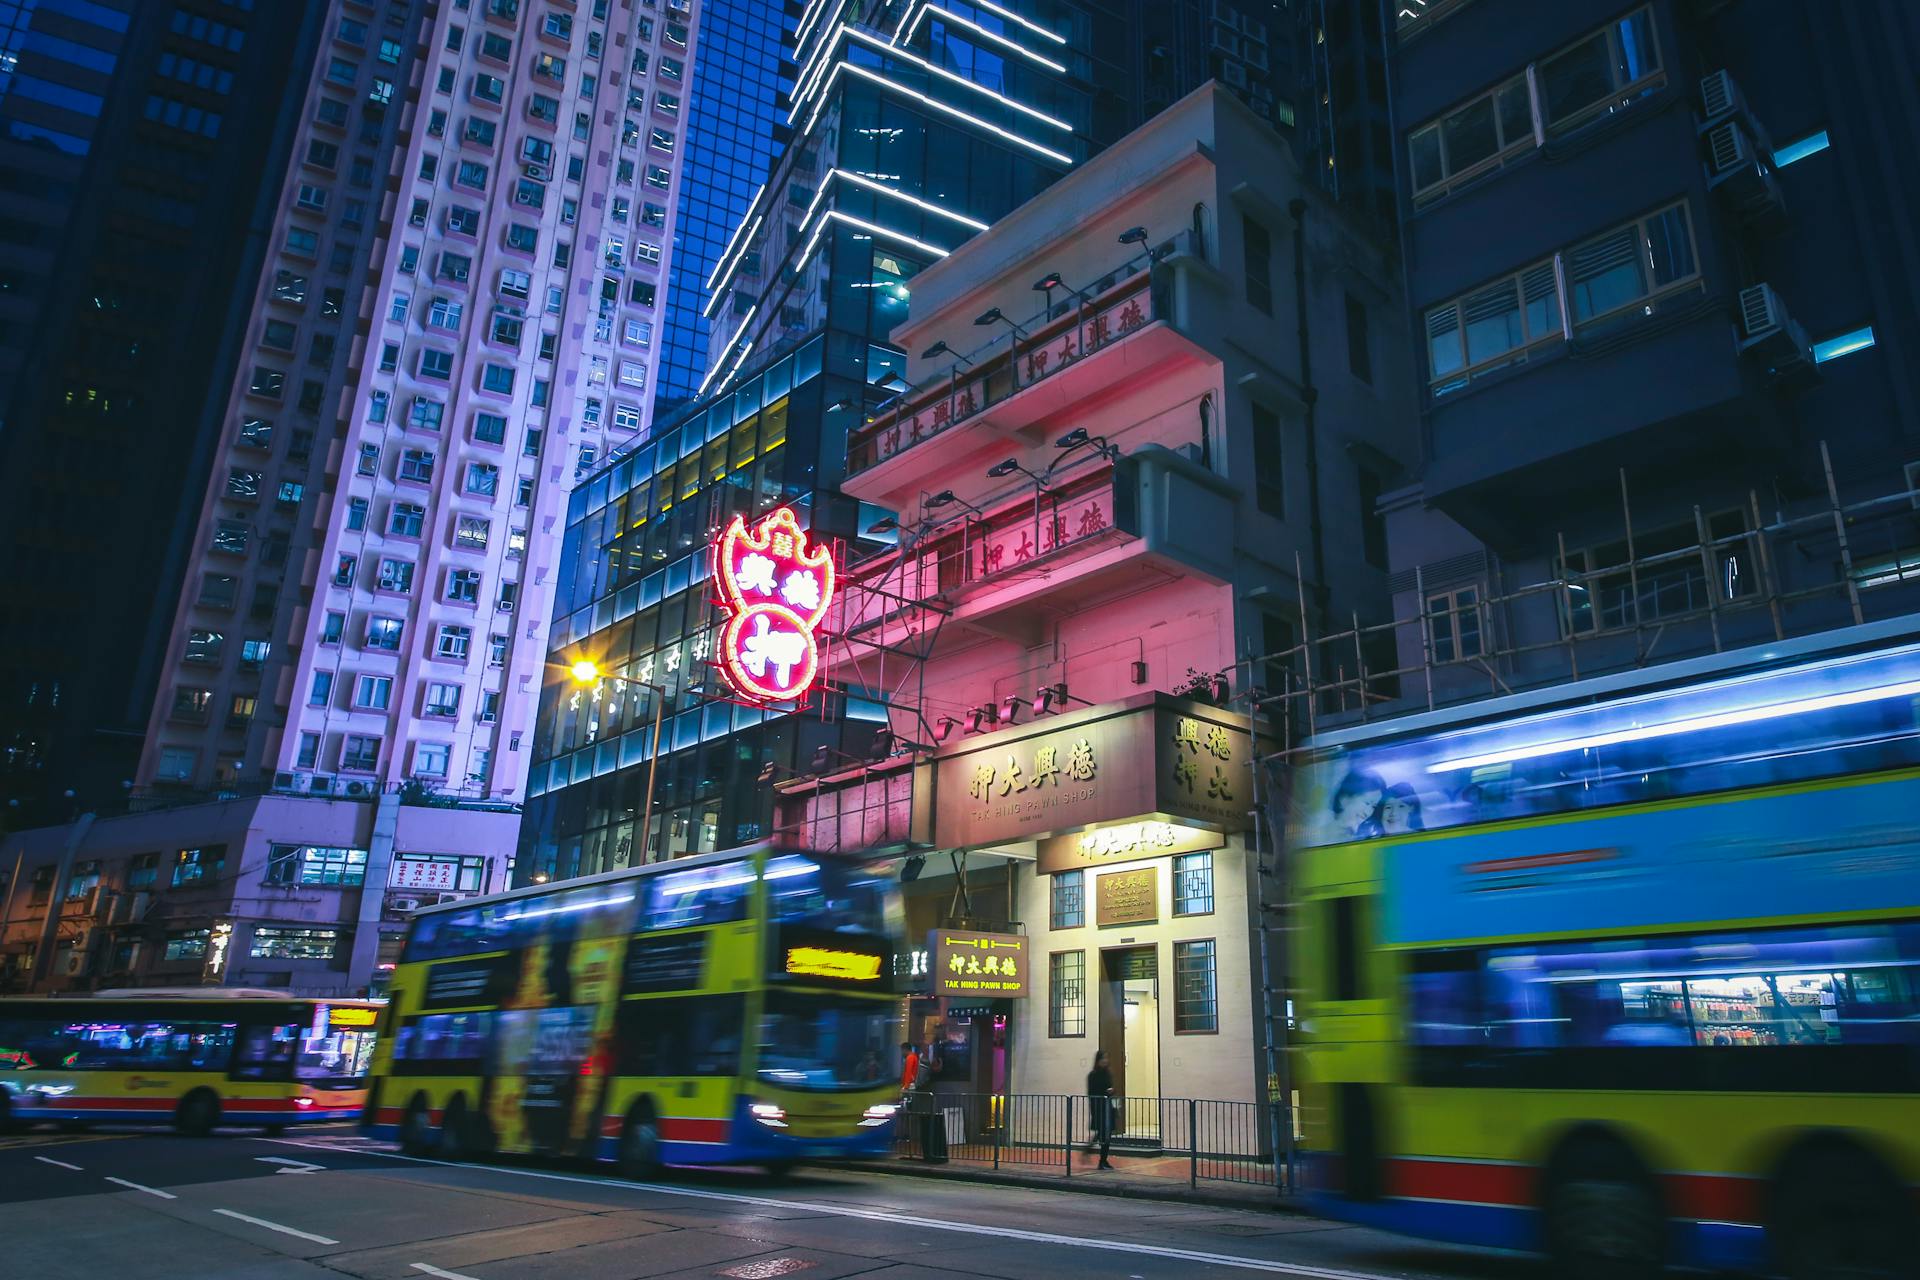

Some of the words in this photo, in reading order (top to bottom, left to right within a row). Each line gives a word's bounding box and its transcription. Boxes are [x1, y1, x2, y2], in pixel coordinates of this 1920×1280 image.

[995, 804, 1021, 818] HING
[1027, 797, 1058, 812] PAWN
[1064, 788, 1096, 804] SHOP
[945, 980, 958, 989] TAK
[961, 980, 978, 989] HING
[981, 981, 1001, 990] PAWN
[1002, 982, 1021, 990] SHOP
